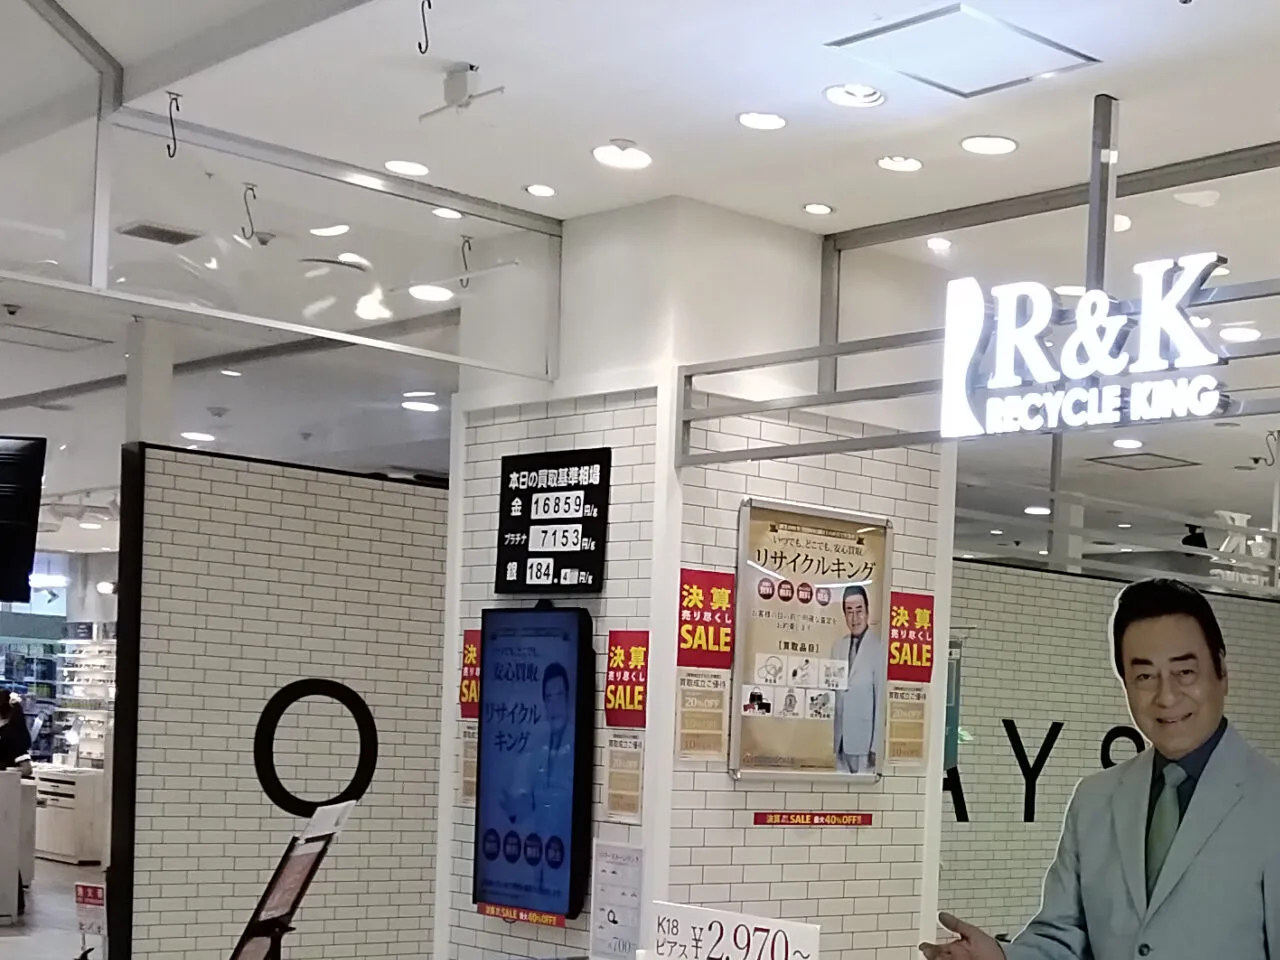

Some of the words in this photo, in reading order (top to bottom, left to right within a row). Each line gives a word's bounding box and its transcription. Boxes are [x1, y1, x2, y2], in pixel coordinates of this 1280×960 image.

[987, 252, 1219, 389] R&K
[986, 384, 1121, 434] RECYCLE
[1130, 375, 1220, 421] KING
[508, 464, 600, 490] 本日の買取基準相場
[510, 497, 522, 516] 金
[533, 496, 581, 515] 16859
[504, 533, 527, 545] プラチナ
[541, 529, 579, 547] 7153
[756, 549, 876, 580] リサイクルキング
[682, 584, 731, 610] 決算
[681, 609, 732, 624] 売り尽くし
[892, 606, 932, 629] 決算
[680, 624, 731, 652] SALE
[464, 644, 477, 665] 決
[610, 646, 646, 669] 決算
[889, 642, 932, 667] SALE
[461, 680, 480, 702] SA
[606, 685, 643, 710] SALE
[485, 703, 541, 725] リサイクル
[494, 731, 531, 754] キング
[657, 916, 679, 935] K18
[656, 938, 688, 959] ピアス
